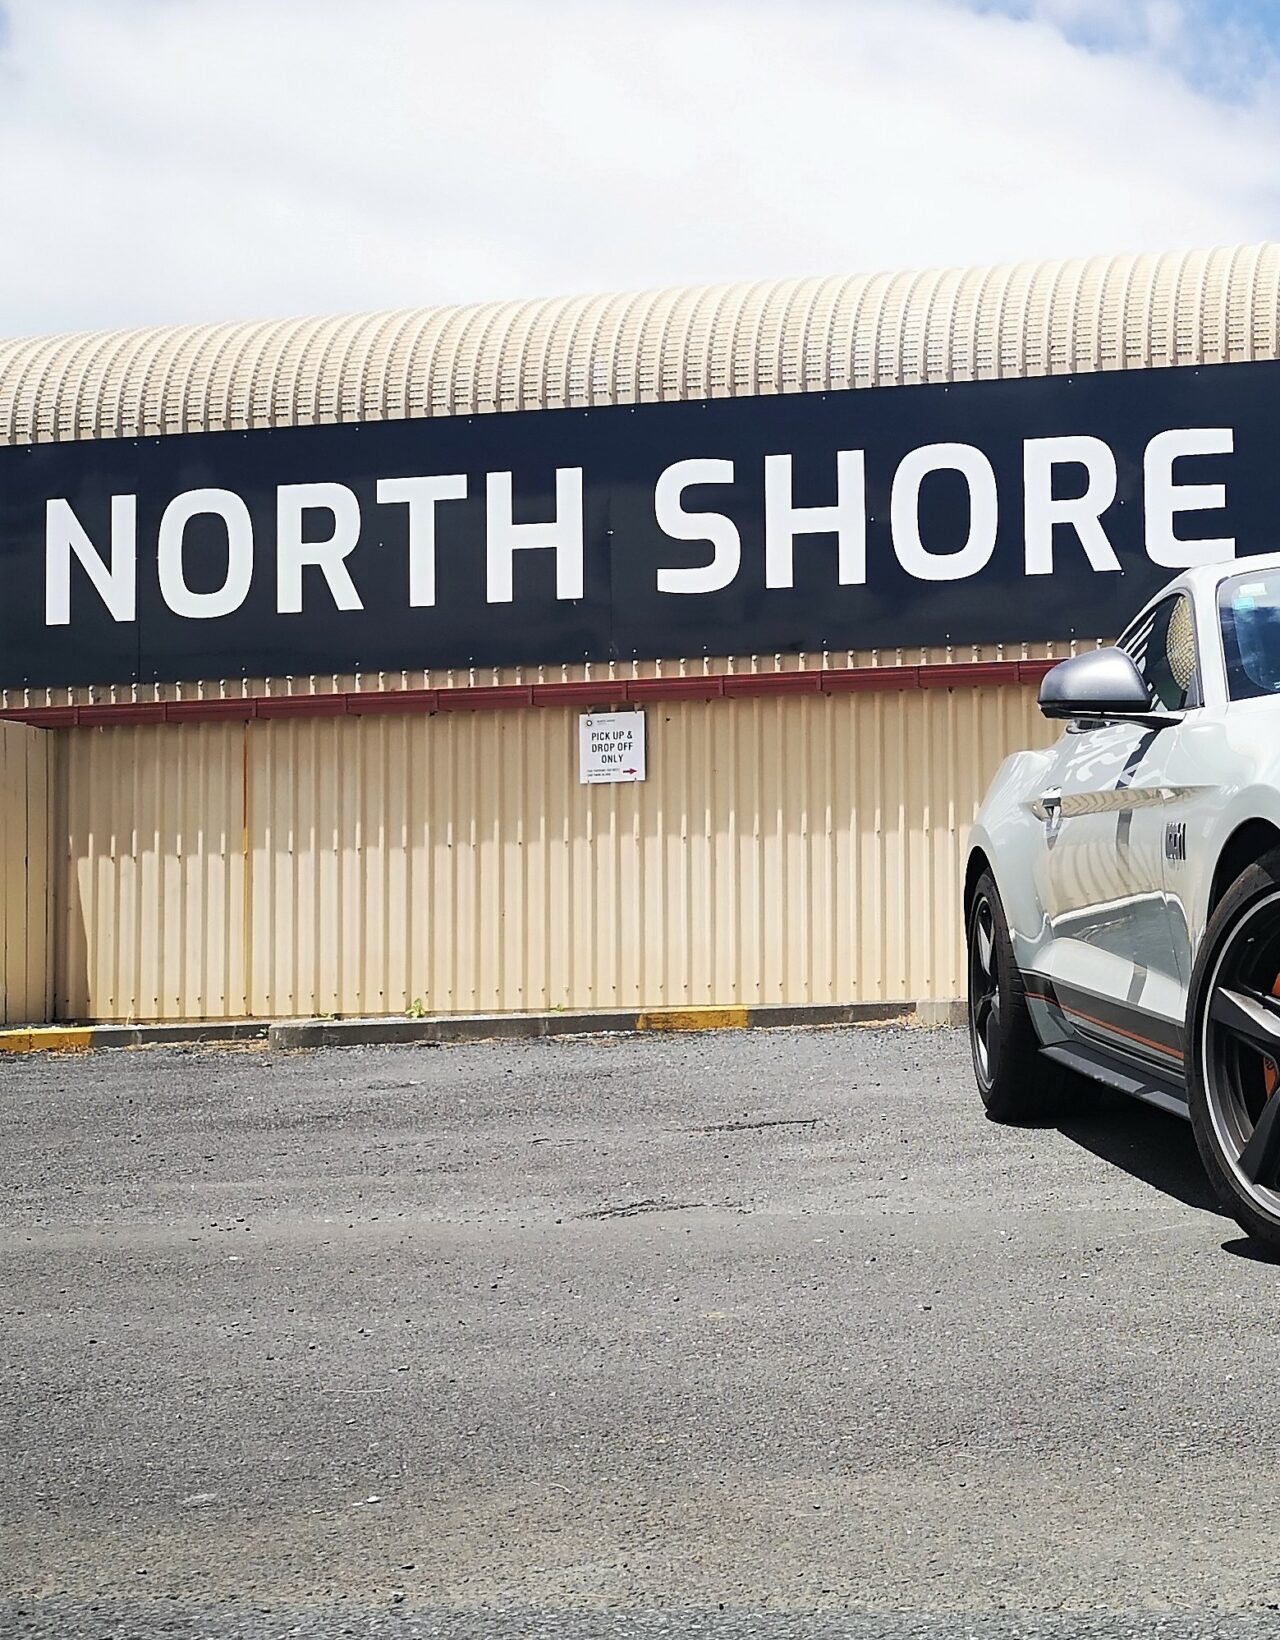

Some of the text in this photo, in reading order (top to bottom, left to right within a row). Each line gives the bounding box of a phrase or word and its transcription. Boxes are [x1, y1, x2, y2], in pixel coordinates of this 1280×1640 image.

[45, 466, 584, 626] NORTH
[654, 428, 1237, 594] SHORE
[592, 730, 632, 741] PICK UP &
[592, 742, 633, 752] DROP OFF
[601, 754, 623, 763] ONLY
